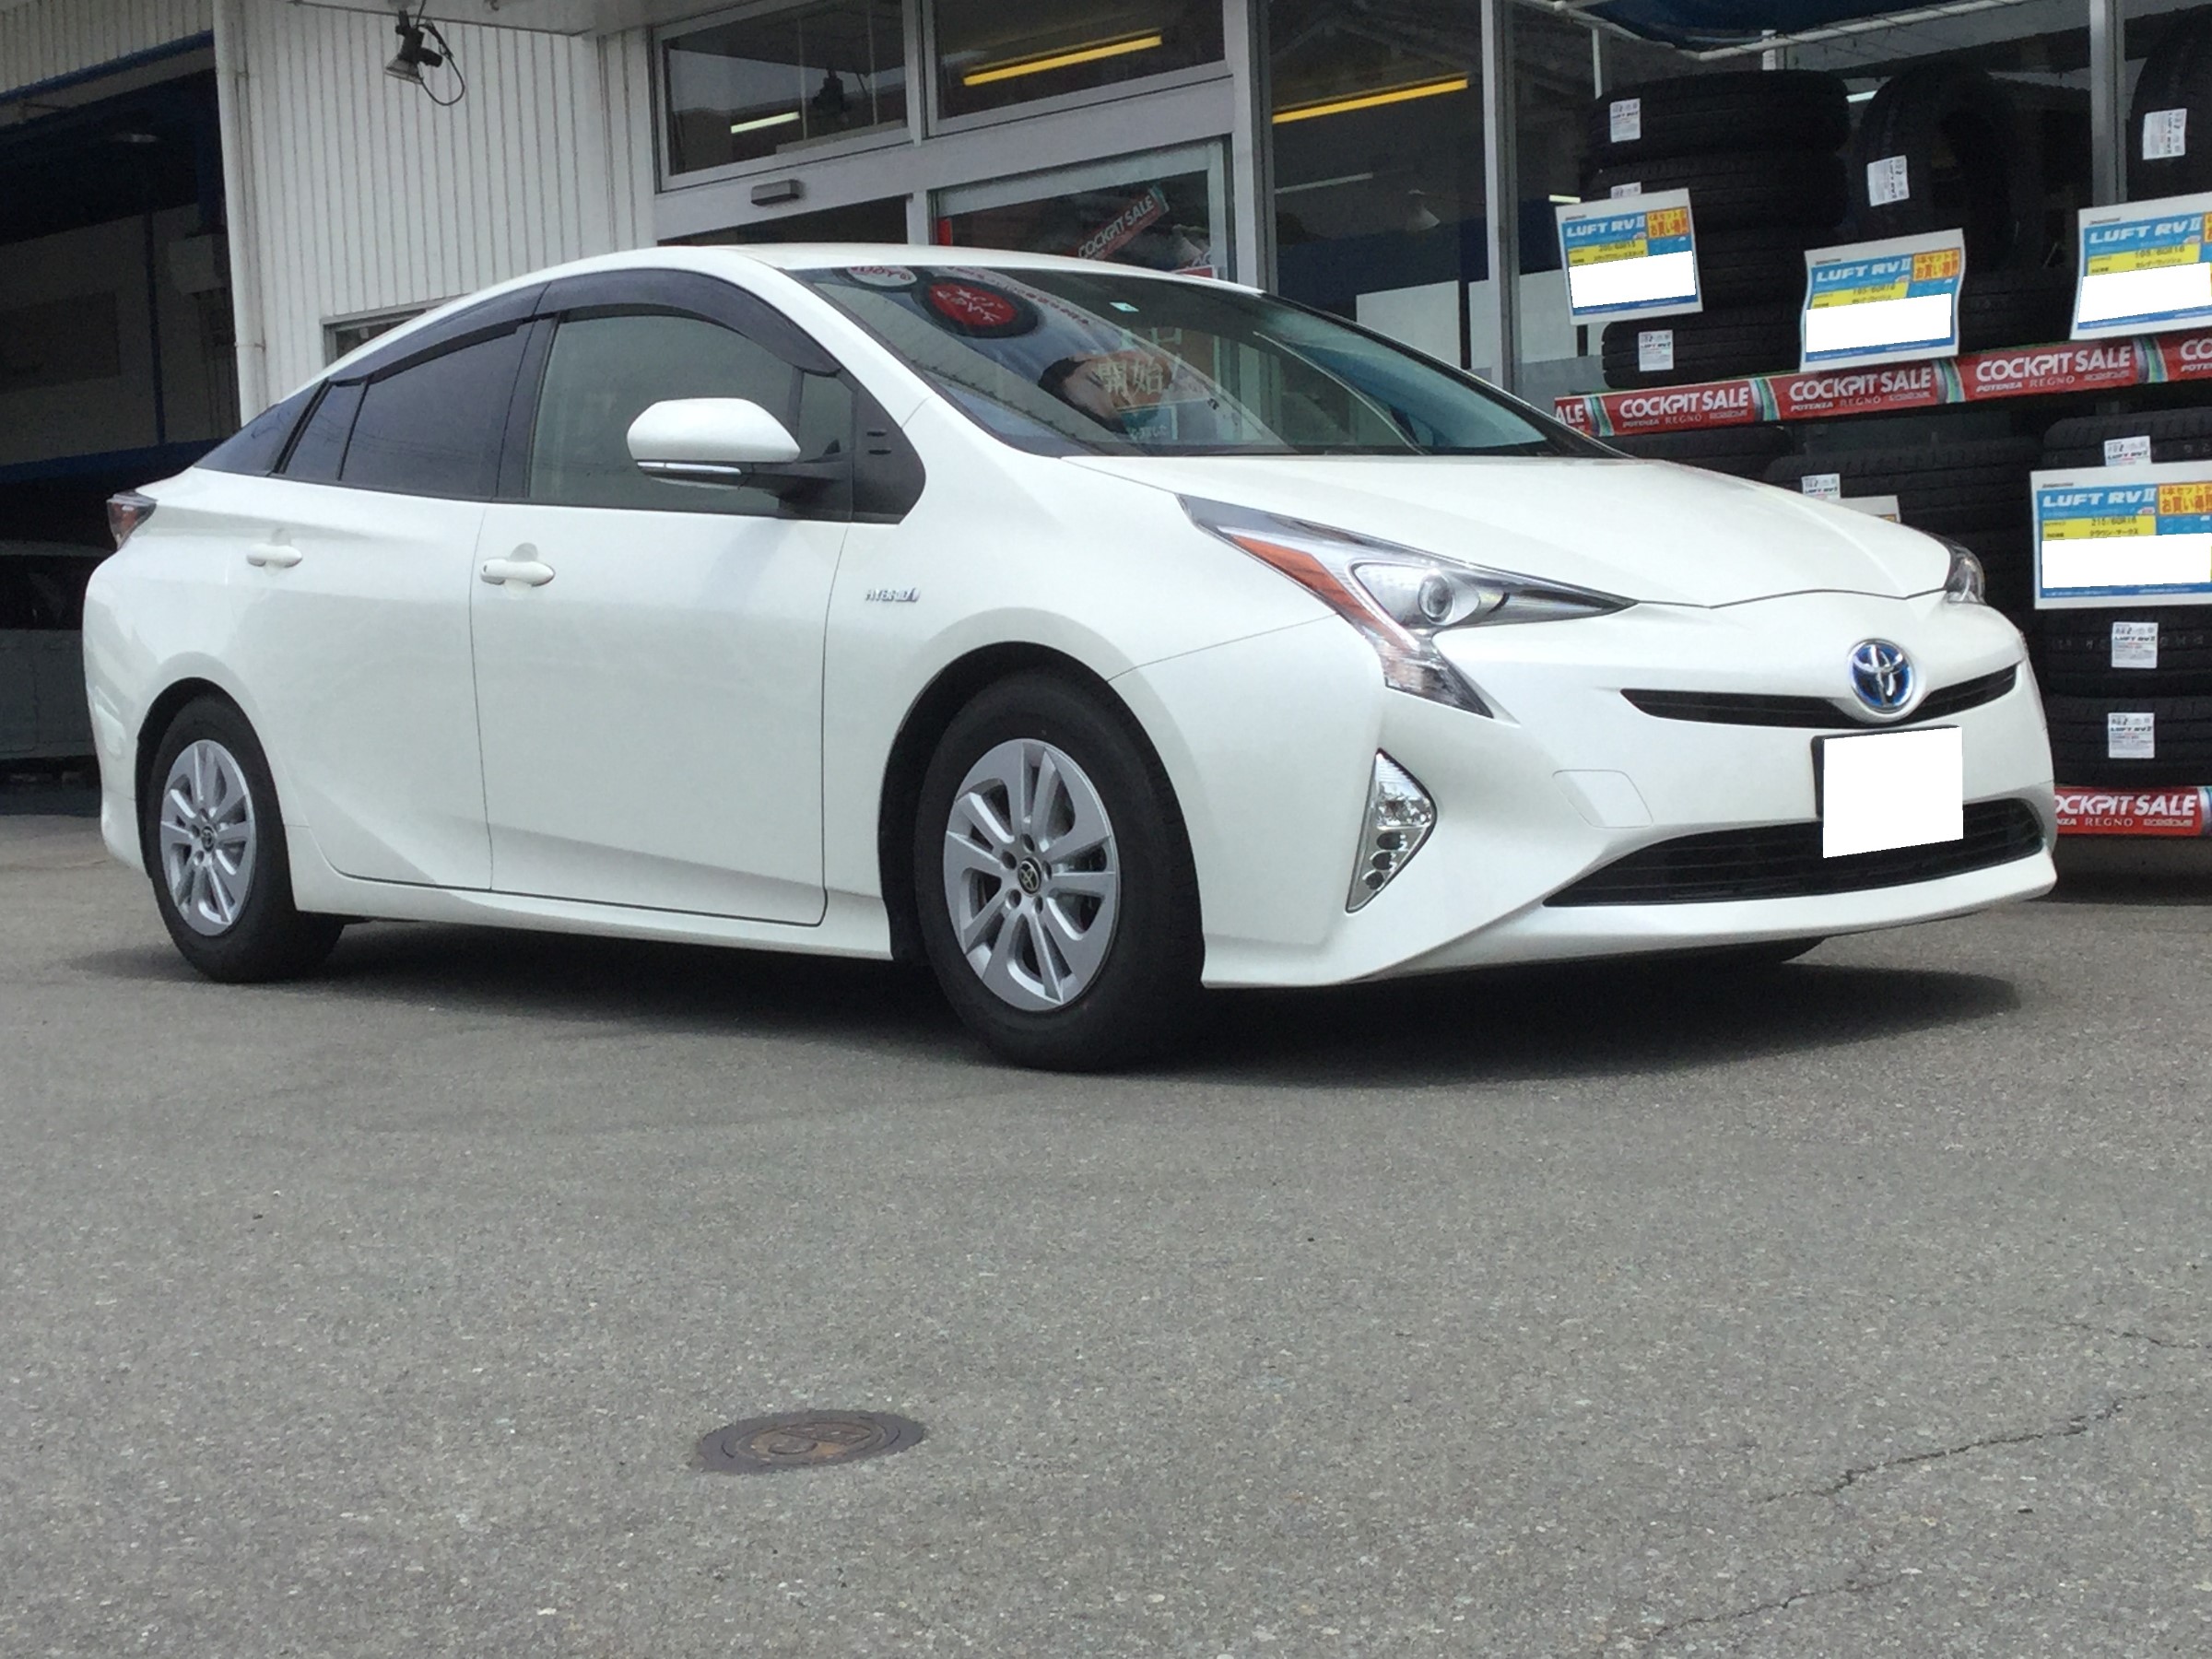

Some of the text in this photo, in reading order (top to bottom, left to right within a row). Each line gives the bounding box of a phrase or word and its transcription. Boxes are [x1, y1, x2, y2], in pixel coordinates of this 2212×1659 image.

[1124, 194, 1155, 227] SALE
[1567, 222, 1608, 237] LUFT
[2089, 225, 2151, 244] LUFT
[1816, 265, 1868, 282] LUFT
[1975, 353, 2073, 382] COCKPIT
[2075, 346, 2132, 372] SALE
[1789, 367, 1932, 401] COCKPIT SALE
[1975, 382, 2023, 393] POTENZA
[2030, 375, 2076, 388] REGNO
[1619, 387, 1749, 418] COCKPIT SALE
[1791, 396, 1881, 412] POTENZA REGNO
[1665, 414, 1702, 425] REGNO
[2042, 493, 2103, 507] LUFT
[2134, 794, 2197, 817] SALE
[2085, 818, 2134, 827] REGNO
